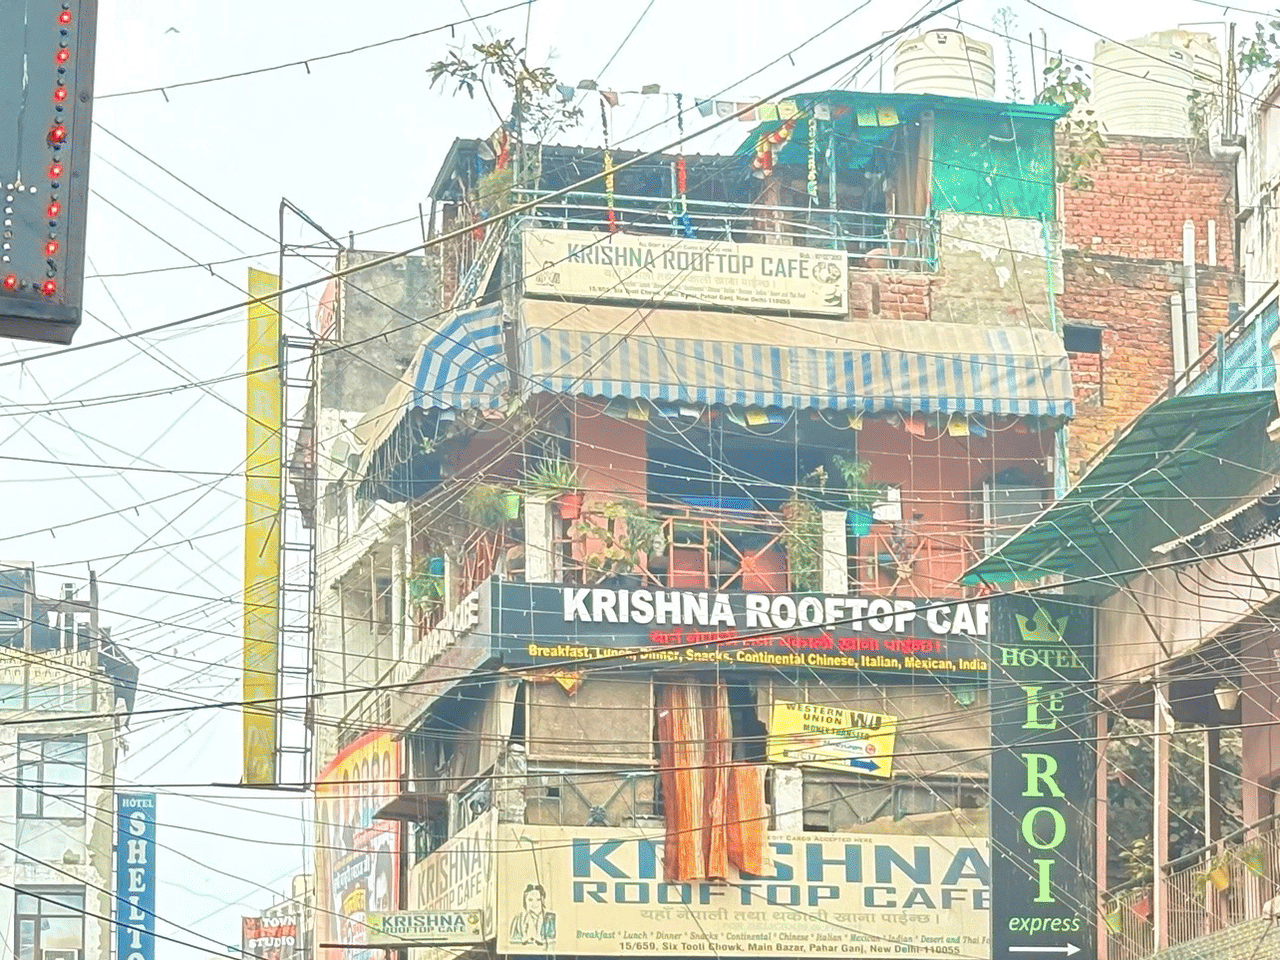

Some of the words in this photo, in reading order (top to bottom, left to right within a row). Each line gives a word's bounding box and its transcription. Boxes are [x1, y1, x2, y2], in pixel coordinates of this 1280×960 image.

[567, 243, 656, 269] KRISHNA
[663, 250, 754, 275] ROOFTOP
[761, 256, 809, 279] CAFE
[563, 587, 736, 627] KRISHNA
[746, 594, 916, 633] ROOFTOP
[528, 644, 592, 659] Breakfast,
[597, 647, 637, 662] Lunch,
[736, 651, 806, 666] Continental
[808, 654, 859, 668] Chinese,
[861, 656, 902, 670] Italian,
[905, 657, 956, 672] Mexican,
[959, 658, 988, 671] India
[1002, 648, 1083, 668] HOTEL
[786, 703, 843, 717] WESTERN
[803, 713, 842, 725] UNION
[1021, 686, 1065, 730] LE
[122, 798, 154, 808] HOTEL
[1021, 753, 1067, 903] ROI
[418, 831, 482, 909] KRISHNA
[572, 837, 990, 886] KSHNA
[458, 871, 482, 906] CAFE
[573, 881, 840, 907] ROOFTOP
[864, 886, 990, 911] CAFE
[382, 914, 466, 927] KRISHNA
[1008, 914, 1081, 937] express
[576, 930, 615, 941] Breakfast
[623, 930, 648, 940] Lunch
[656, 931, 682, 940] Dinner
[726, 932, 771, 941] Continental
[946, 934, 961, 944] and
[962, 935, 980, 944] Thai
[662, 942, 678, 951] Six
[708, 943, 745, 952] Chowk,
[748, 943, 773, 951] Main
[776, 943, 806, 953] Bazar,
[809, 944, 837, 953] Pahar
[841, 944, 867, 954] Ganj,
[870, 945, 891, 953] New
